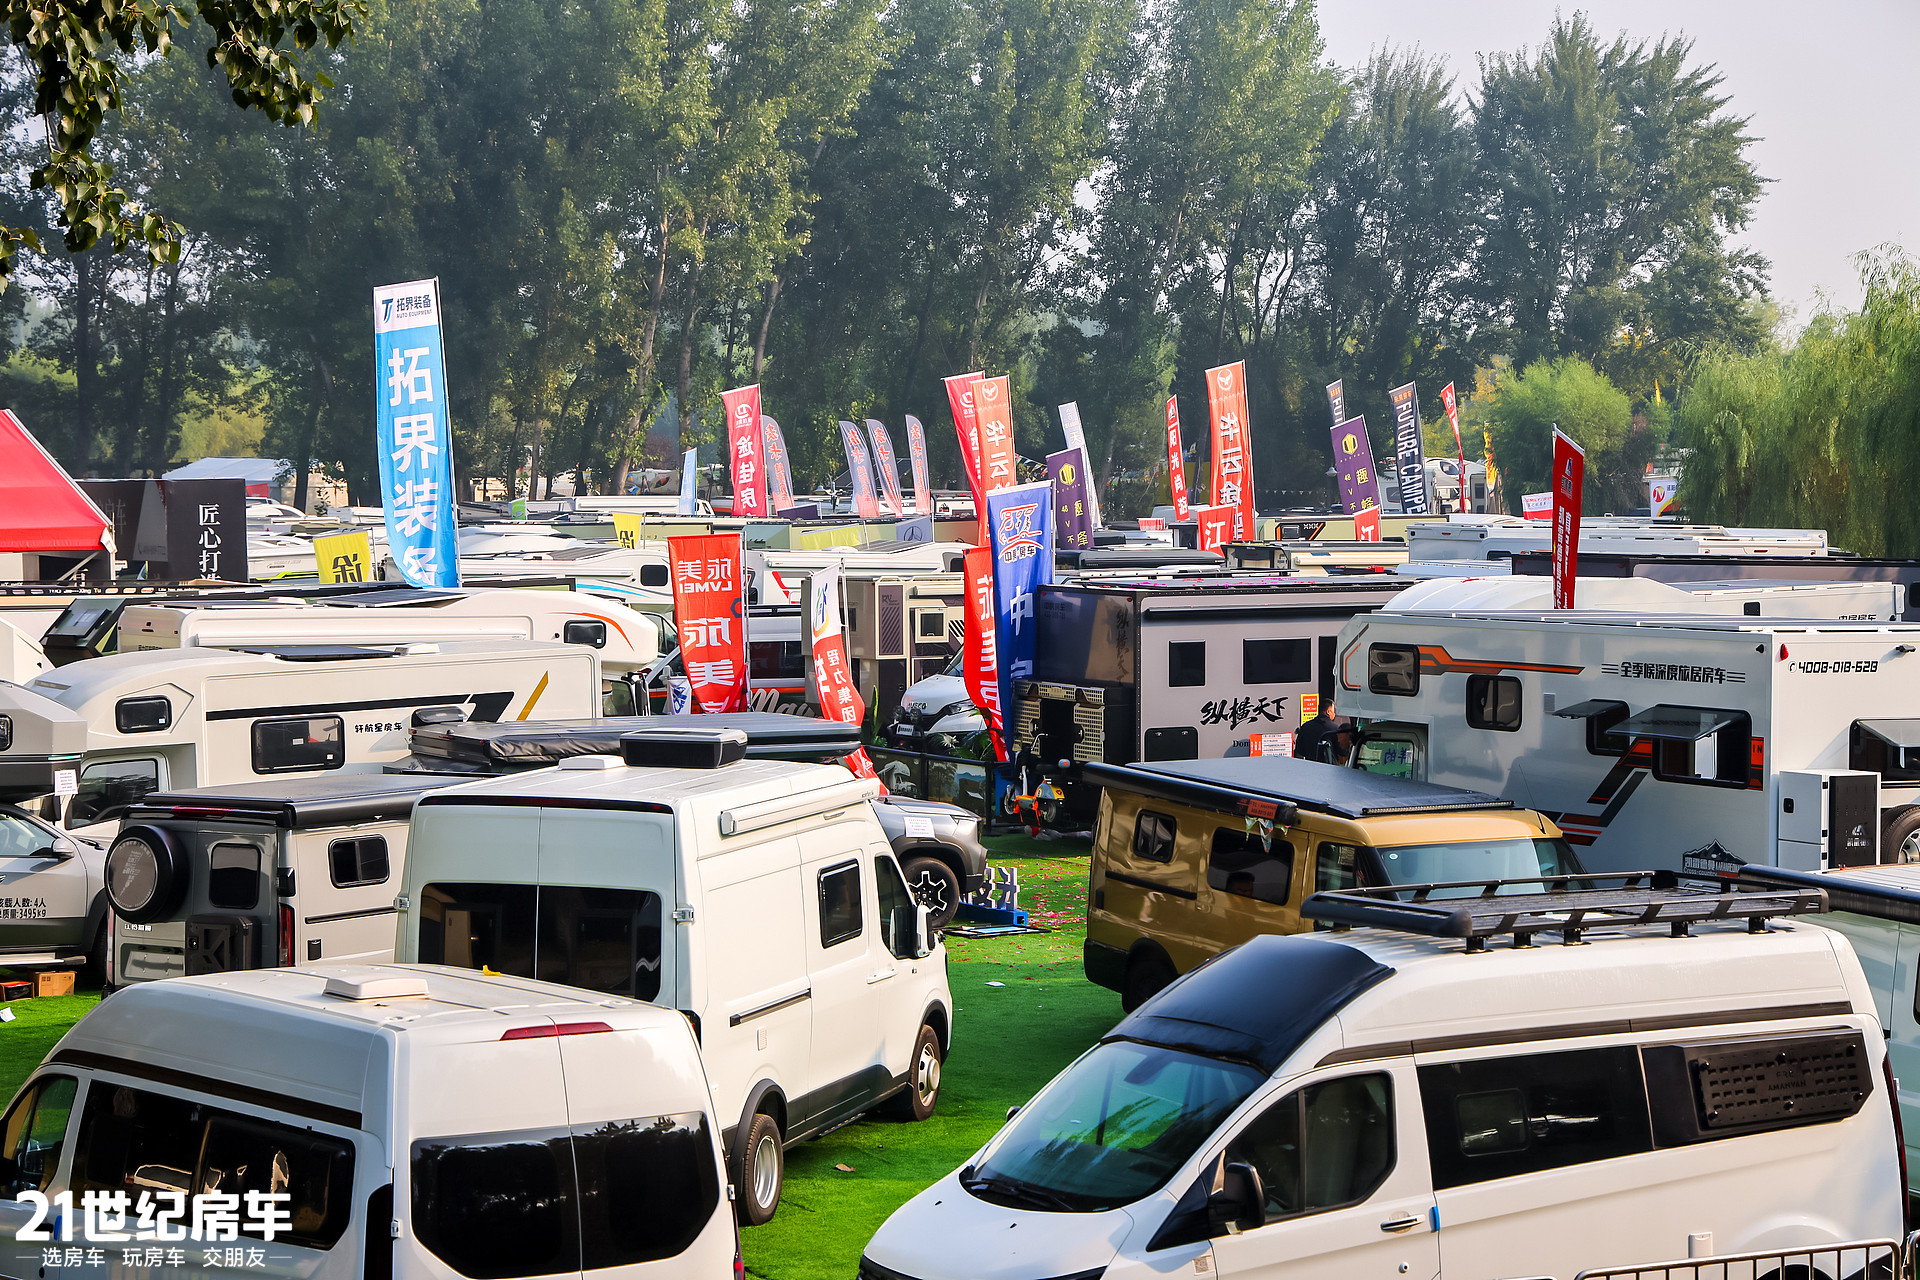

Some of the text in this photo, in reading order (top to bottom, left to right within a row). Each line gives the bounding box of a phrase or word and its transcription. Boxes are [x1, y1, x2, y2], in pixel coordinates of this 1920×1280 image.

[396, 294, 432, 312] 拓界装备
[1395, 401, 1420, 460] FUTURE
[1168, 429, 1189, 516] 阳光尚游
[1400, 463, 1428, 514] CAMPE
[1205, 521, 1227, 550] 江
[1620, 661, 1726, 684] 全季候深度旅居房车
[354, 721, 403, 733] 轩航星房车
[1200, 696, 1289, 731] 纵横天下
[0, 908, 47, 919] 质量:3495kg
